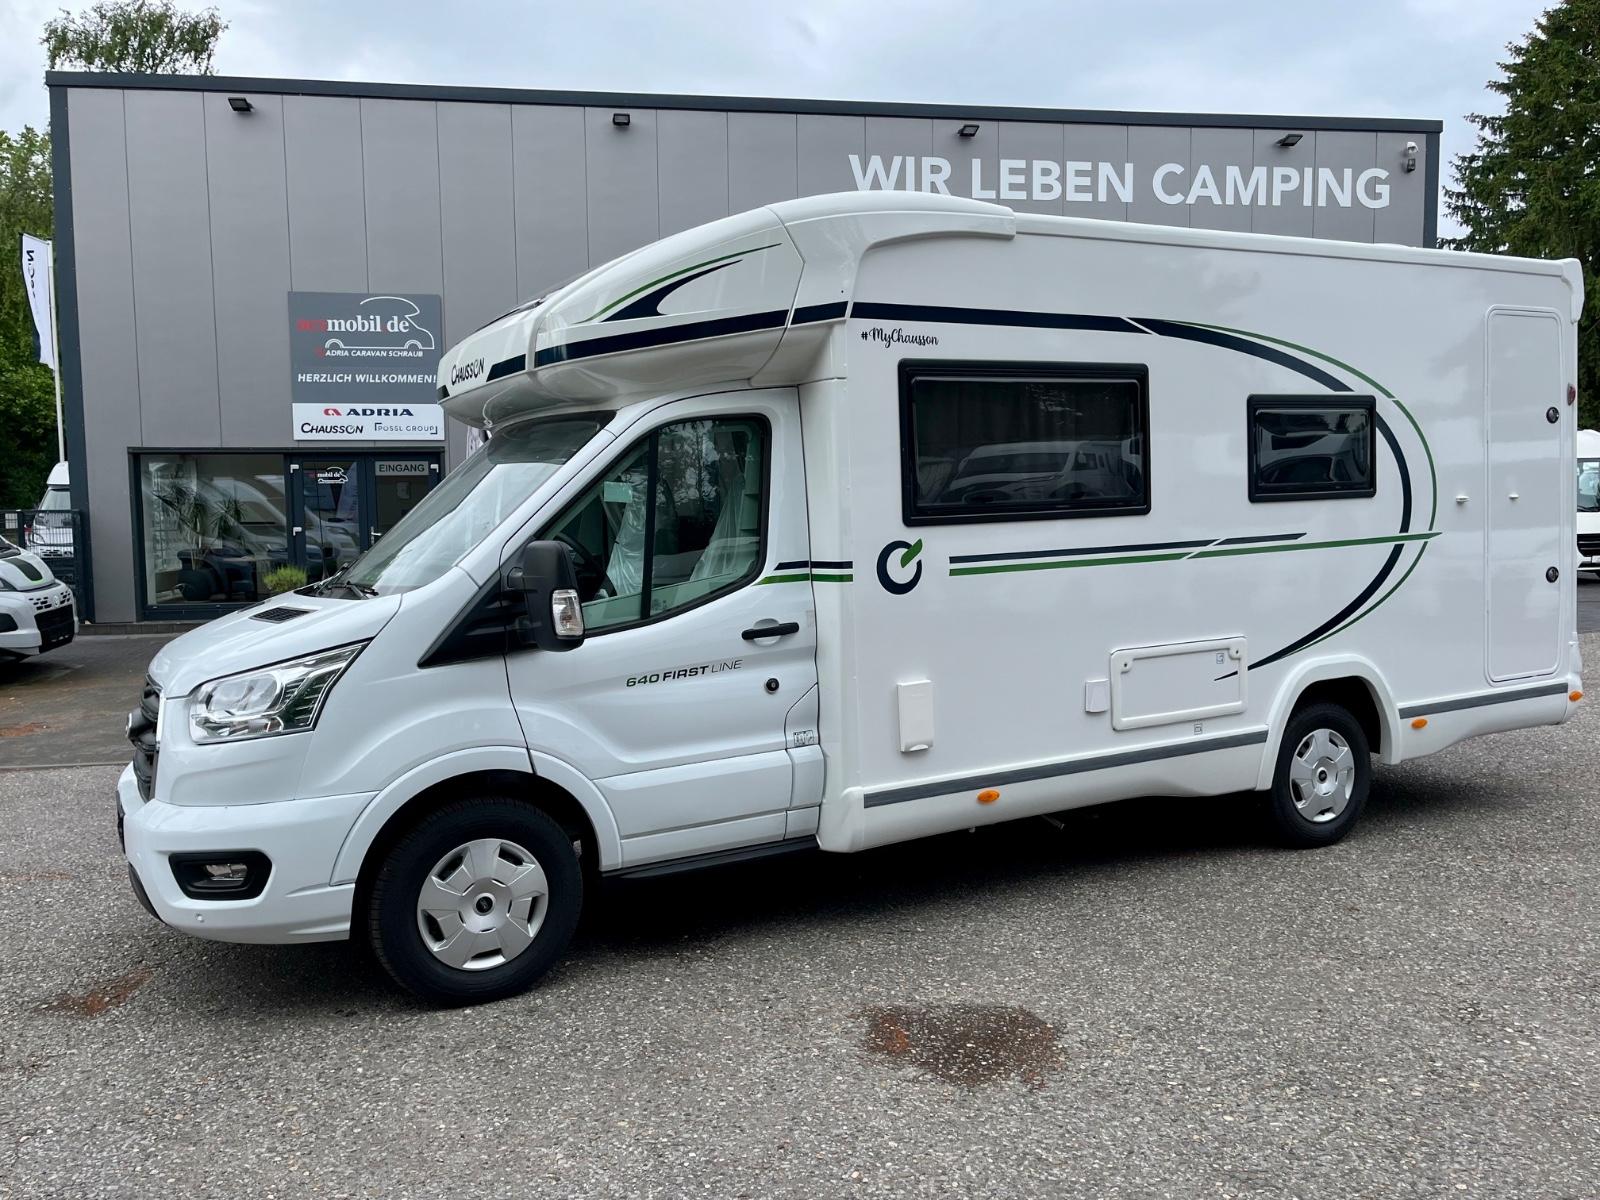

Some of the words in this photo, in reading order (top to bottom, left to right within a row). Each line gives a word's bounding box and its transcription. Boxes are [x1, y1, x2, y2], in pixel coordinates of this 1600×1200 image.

[849, 155, 951, 195] WIR
[971, 158, 1134, 203] LEBEN
[1152, 163, 1390, 208] CAMPING
[861, 327, 939, 348] #MyChausson
[388, 350, 423, 358] SCHRAUB
[297, 373, 352, 383] HERZLICH
[355, 374, 437, 383] WILLKOMMEN!
[346, 408, 414, 416] ADRIA
[301, 422, 364, 434] CHAUSSON
[379, 464, 425, 472] EINGANG
[626, 673, 660, 687] 640
[662, 665, 709, 681] FIRST
[711, 659, 743, 673] LINE
